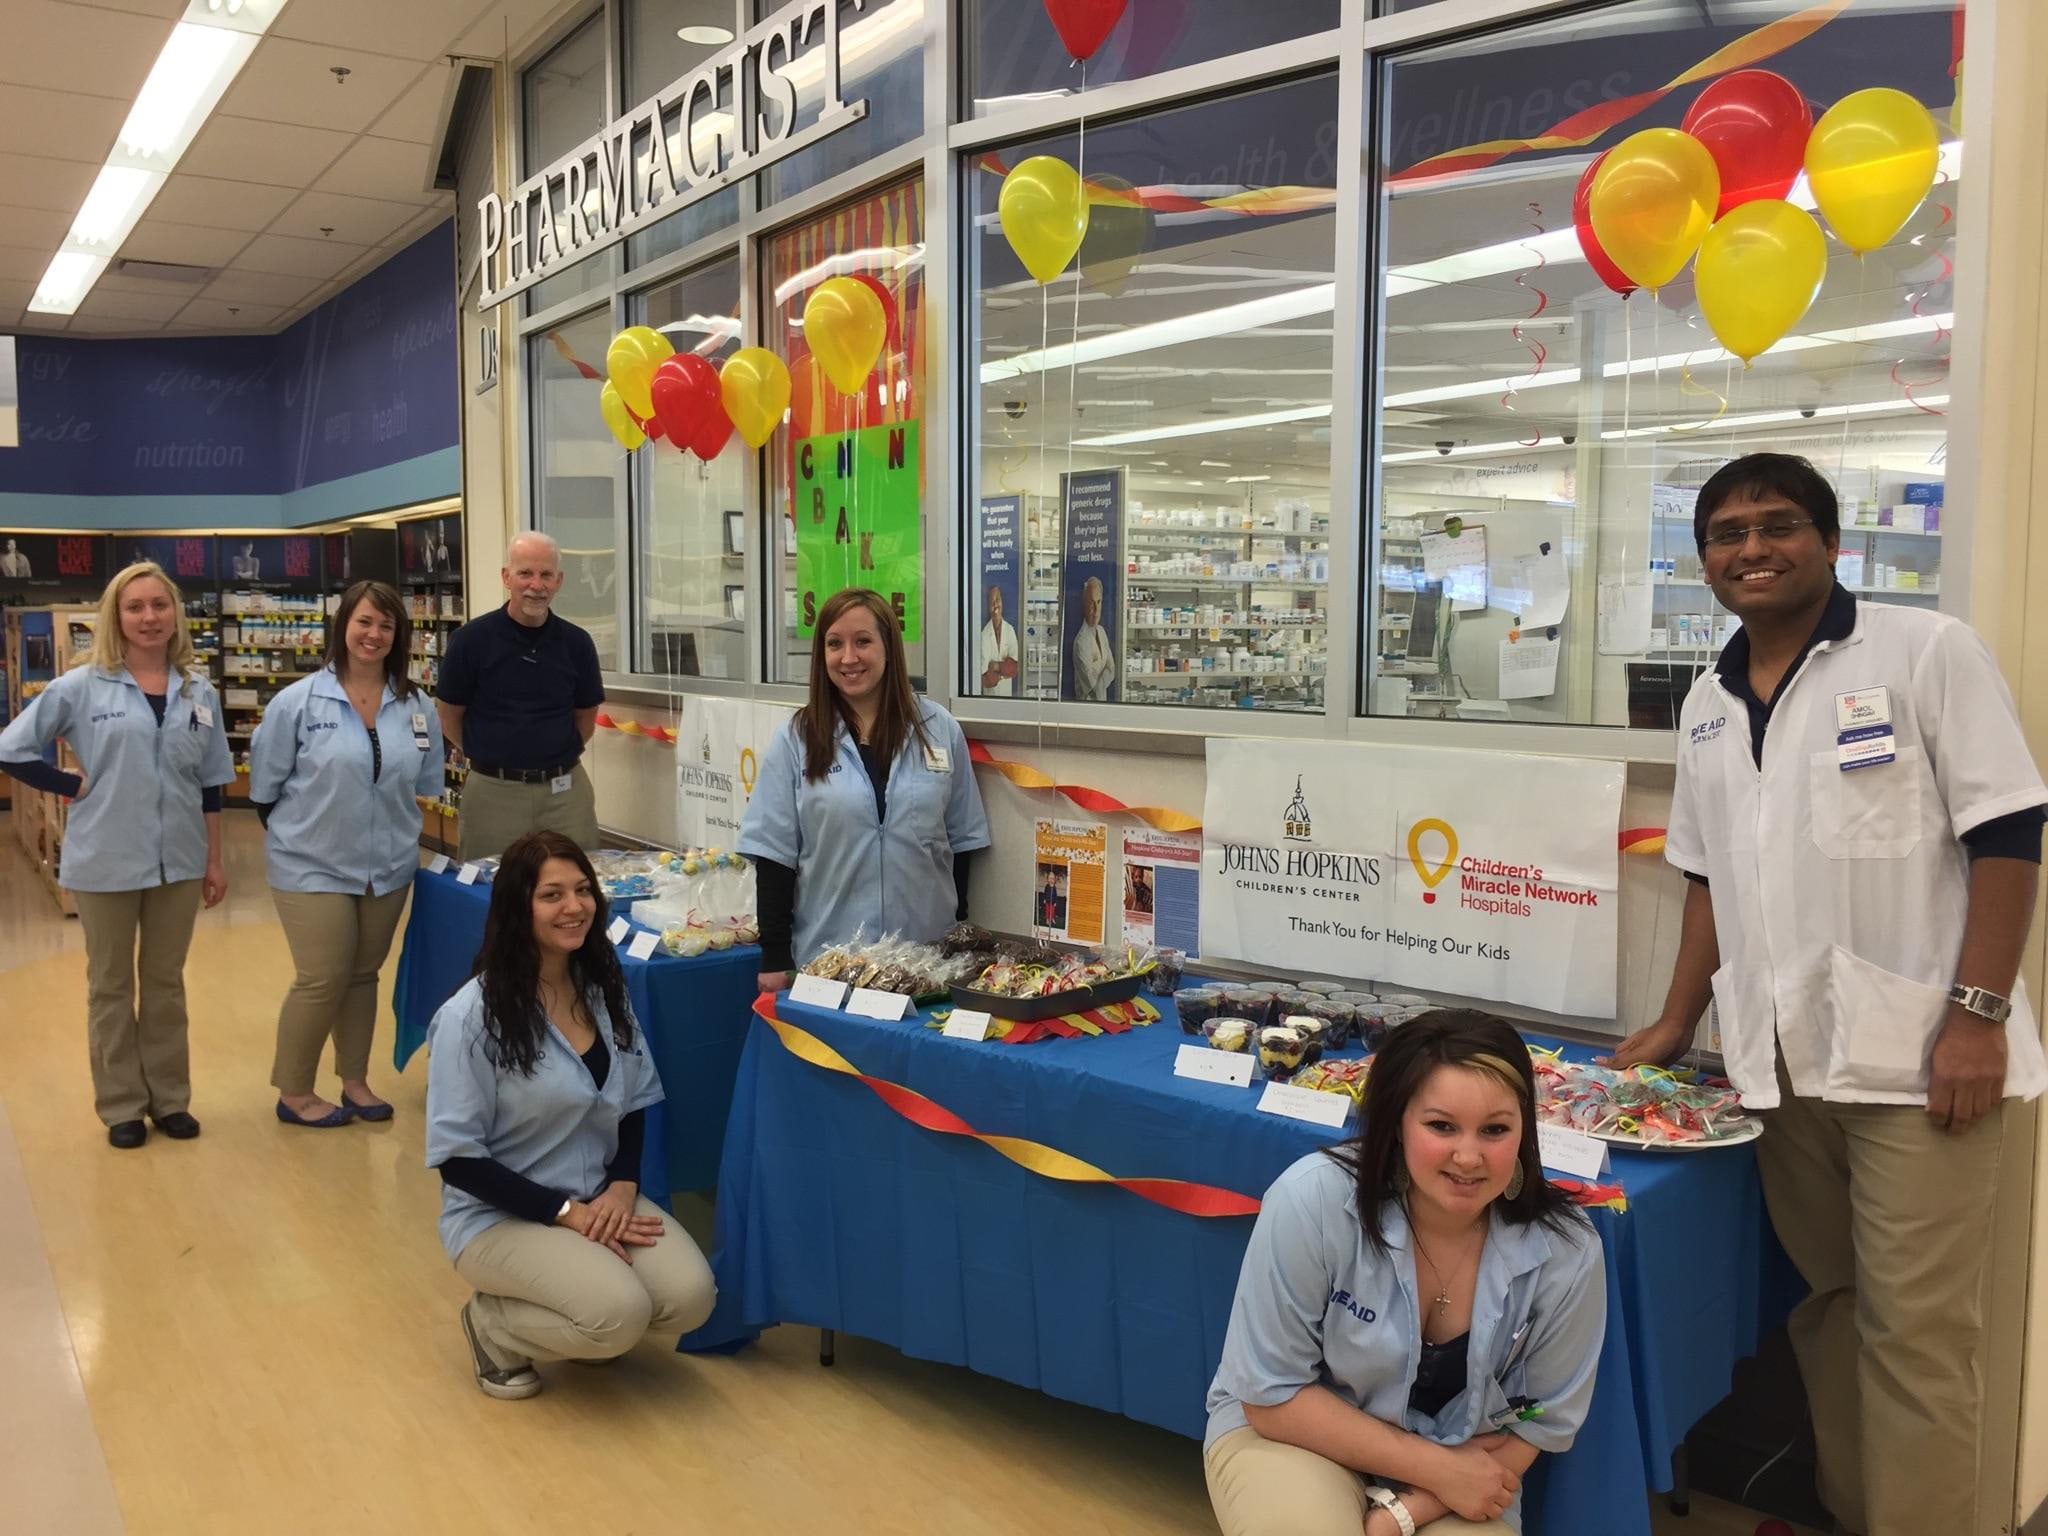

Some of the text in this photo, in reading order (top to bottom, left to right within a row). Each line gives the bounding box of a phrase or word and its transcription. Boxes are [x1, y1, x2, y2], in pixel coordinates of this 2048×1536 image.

[477, 0, 852, 298] PHARMACIST
[134, 439, 245, 468] nutrition
[1477, 462, 1538, 477] expert advice
[1075, 481, 1111, 494] recommend
[1071, 496, 1112, 511] generic drugs
[1079, 511, 1103, 521] because
[1075, 524, 1108, 536] they're just
[1073, 537, 1109, 550] as good but
[1077, 551, 1104, 562] cost less.
[1708, 717, 1726, 731] AID
[1219, 844, 1380, 886] JOHNS HOPKINS
[1460, 856, 1543, 881] Children's
[1236, 879, 1360, 902] CHILDREN'S CENTER
[1461, 874, 1598, 906] Miracle Network
[1460, 893, 1531, 917] Hospitals
[1288, 916, 1510, 960] Thank You for Helping Our Kids
[1347, 1300, 1377, 1323] AID
